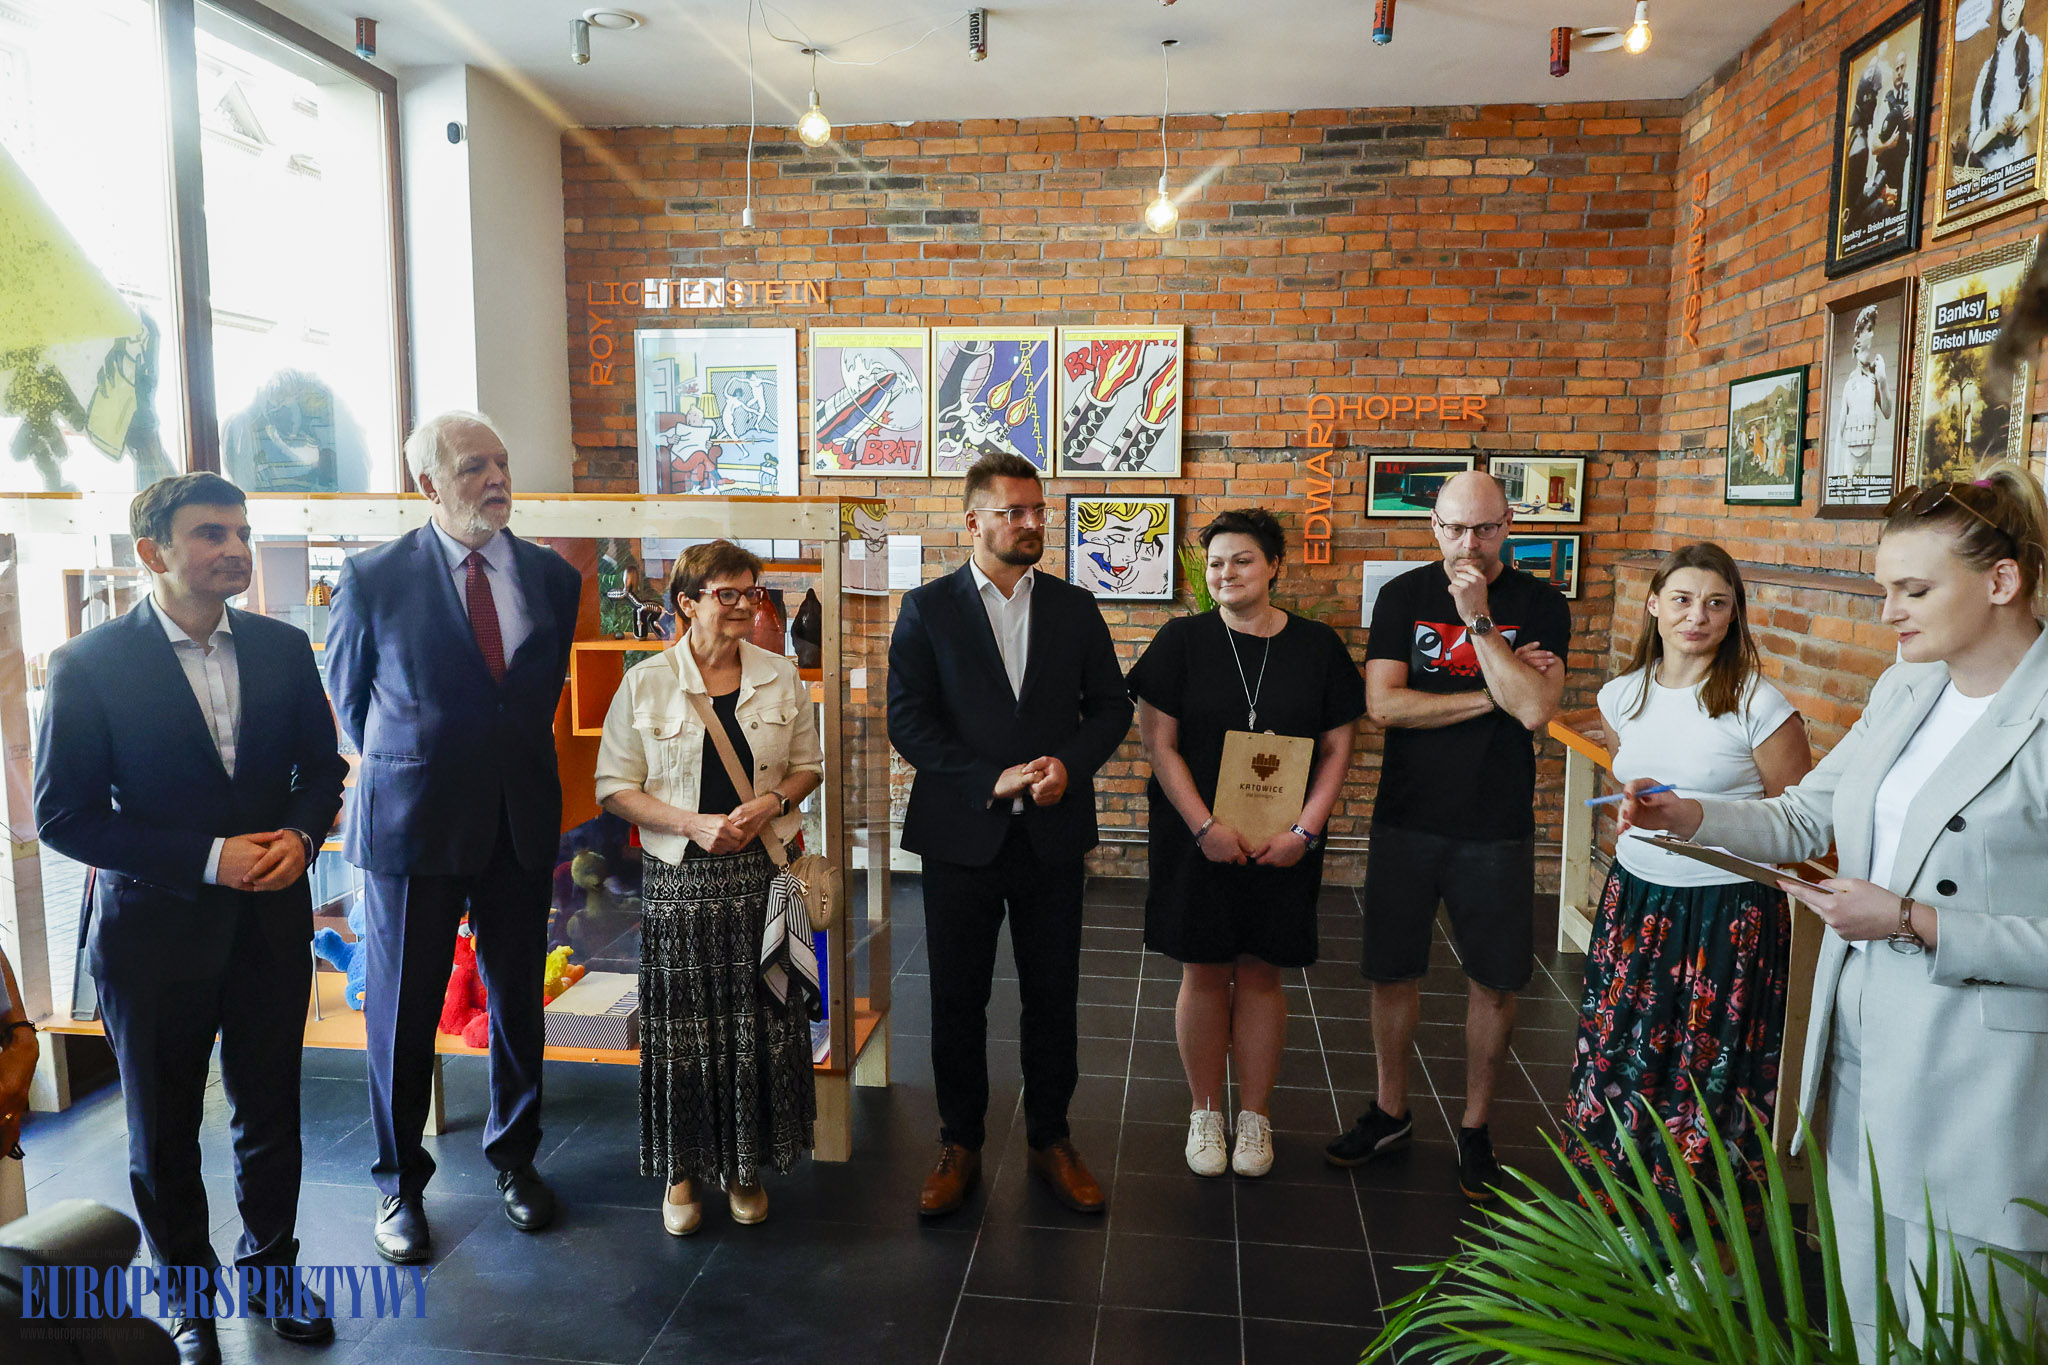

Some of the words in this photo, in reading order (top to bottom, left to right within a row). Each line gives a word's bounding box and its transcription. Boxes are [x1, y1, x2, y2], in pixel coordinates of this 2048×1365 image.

[970, 12, 980, 51] KOBRA
[1946, 182, 1972, 200] Banksy
[1980, 171, 2004, 187] Bristol
[2005, 157, 2037, 177] Museum
[1683, 172, 1709, 345] BANKSY
[587, 280, 827, 306] LICHTENSTEIN
[1938, 299, 1985, 326] Banksy
[1989, 308, 2000, 320] vs
[589, 310, 614, 386] ROY
[1932, 330, 1966, 351] Bristol
[1968, 328, 2002, 346] Muse
[1339, 395, 1488, 421] HOPPER
[861, 436, 922, 470] BRAT!
[1303, 394, 1335, 565] EDWARD
[1240, 783, 1284, 794] KATOWICE
